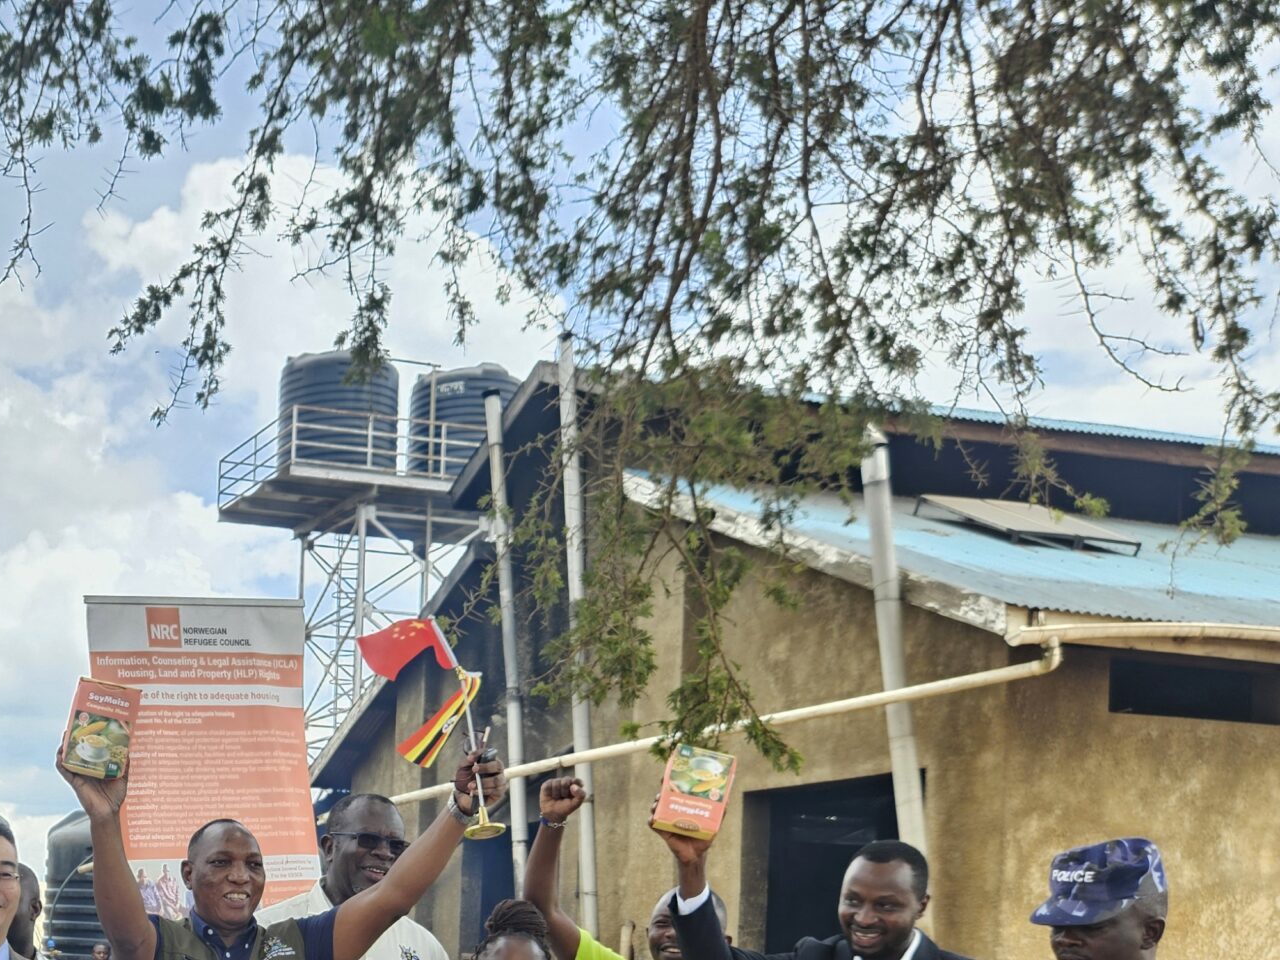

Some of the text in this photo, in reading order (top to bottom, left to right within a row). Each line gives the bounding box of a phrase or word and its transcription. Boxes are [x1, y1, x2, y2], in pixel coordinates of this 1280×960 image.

[150, 623, 180, 641] NRC
[182, 627, 228, 635] NORWEGIAN
[184, 638, 251, 647] REFUGEE COUNCIL
[96, 656, 151, 667] Information,
[152, 656, 198, 667] Counseling
[200, 657, 205, 666] &
[207, 657, 229, 668] Legal
[231, 657, 272, 668] Assistance
[118, 668, 280, 681] Housing, Land and Property (HLP) Rights
[88, 692, 130, 708] SoyMaize
[151, 690, 280, 703] of the right to adequate housing
[1051, 869, 1095, 883] POLICE
